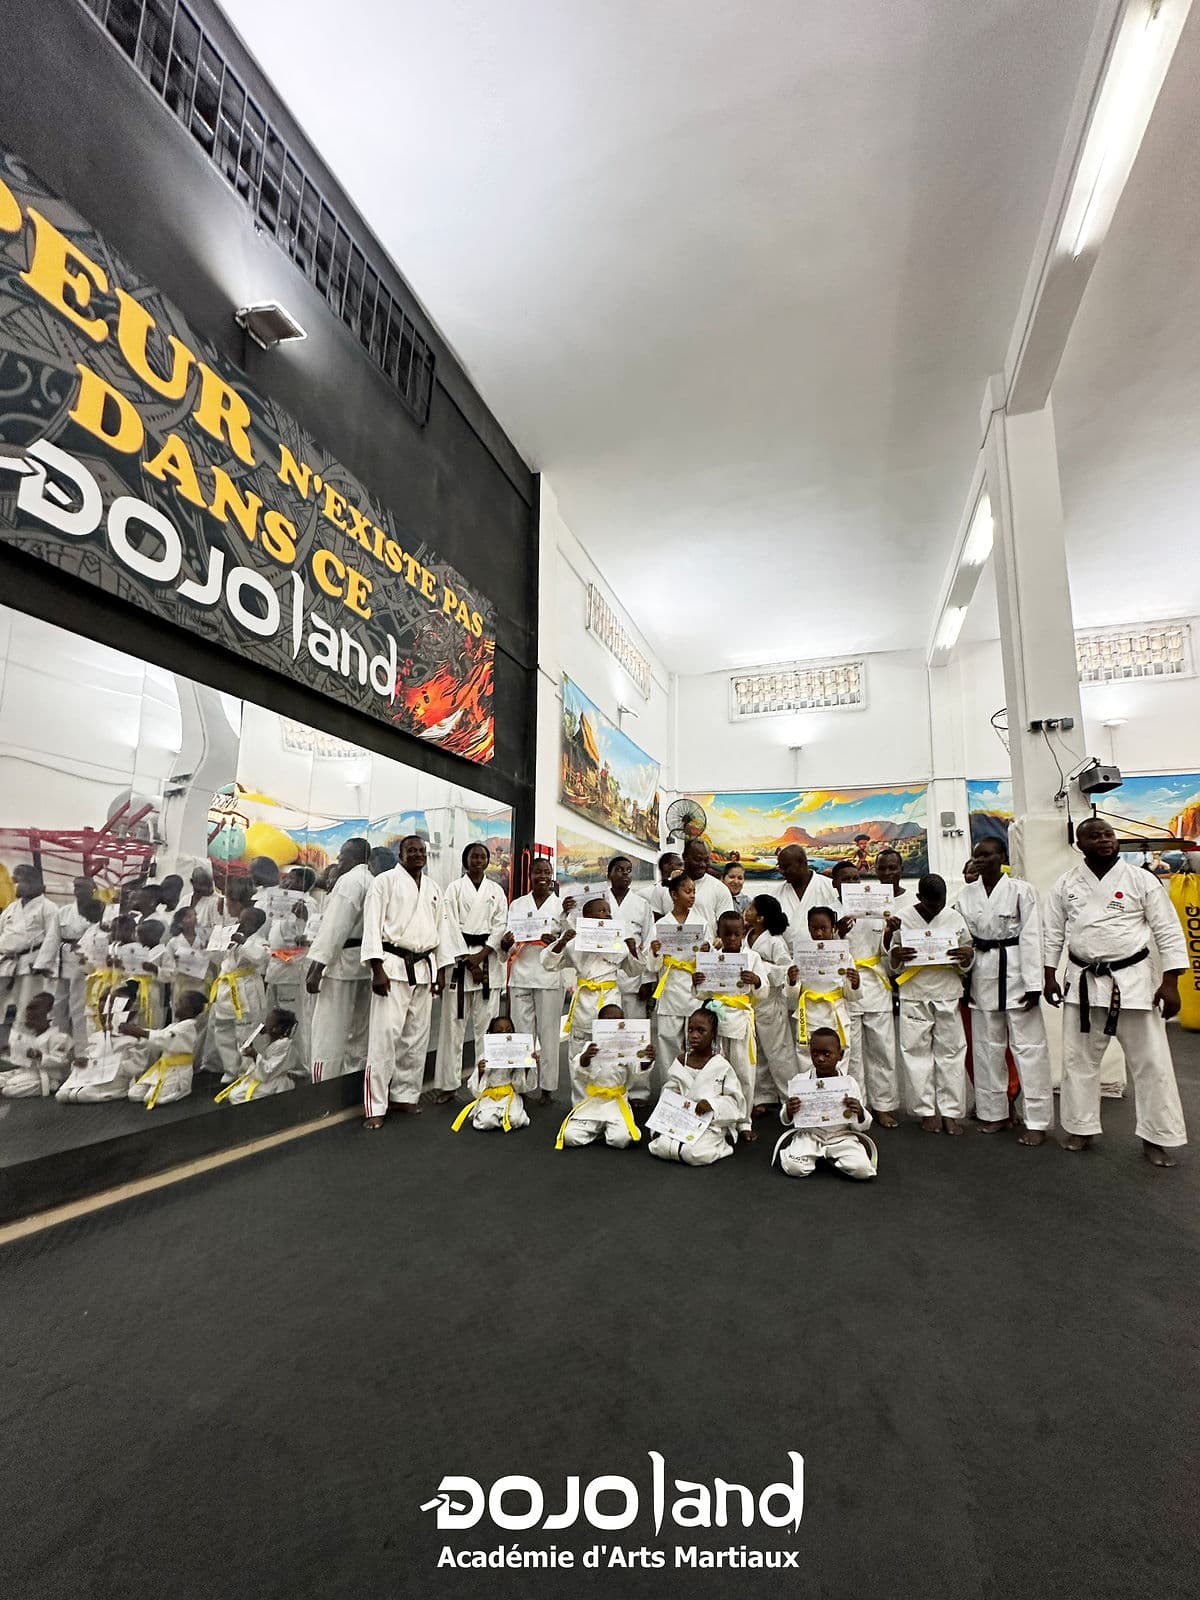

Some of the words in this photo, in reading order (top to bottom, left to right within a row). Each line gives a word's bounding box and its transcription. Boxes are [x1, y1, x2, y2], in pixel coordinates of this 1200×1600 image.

[69, 362, 298, 564] DANS
[312, 549, 374, 620] CE
[278, 443, 437, 602] N'EXISTE
[443, 587, 484, 638] PAS
